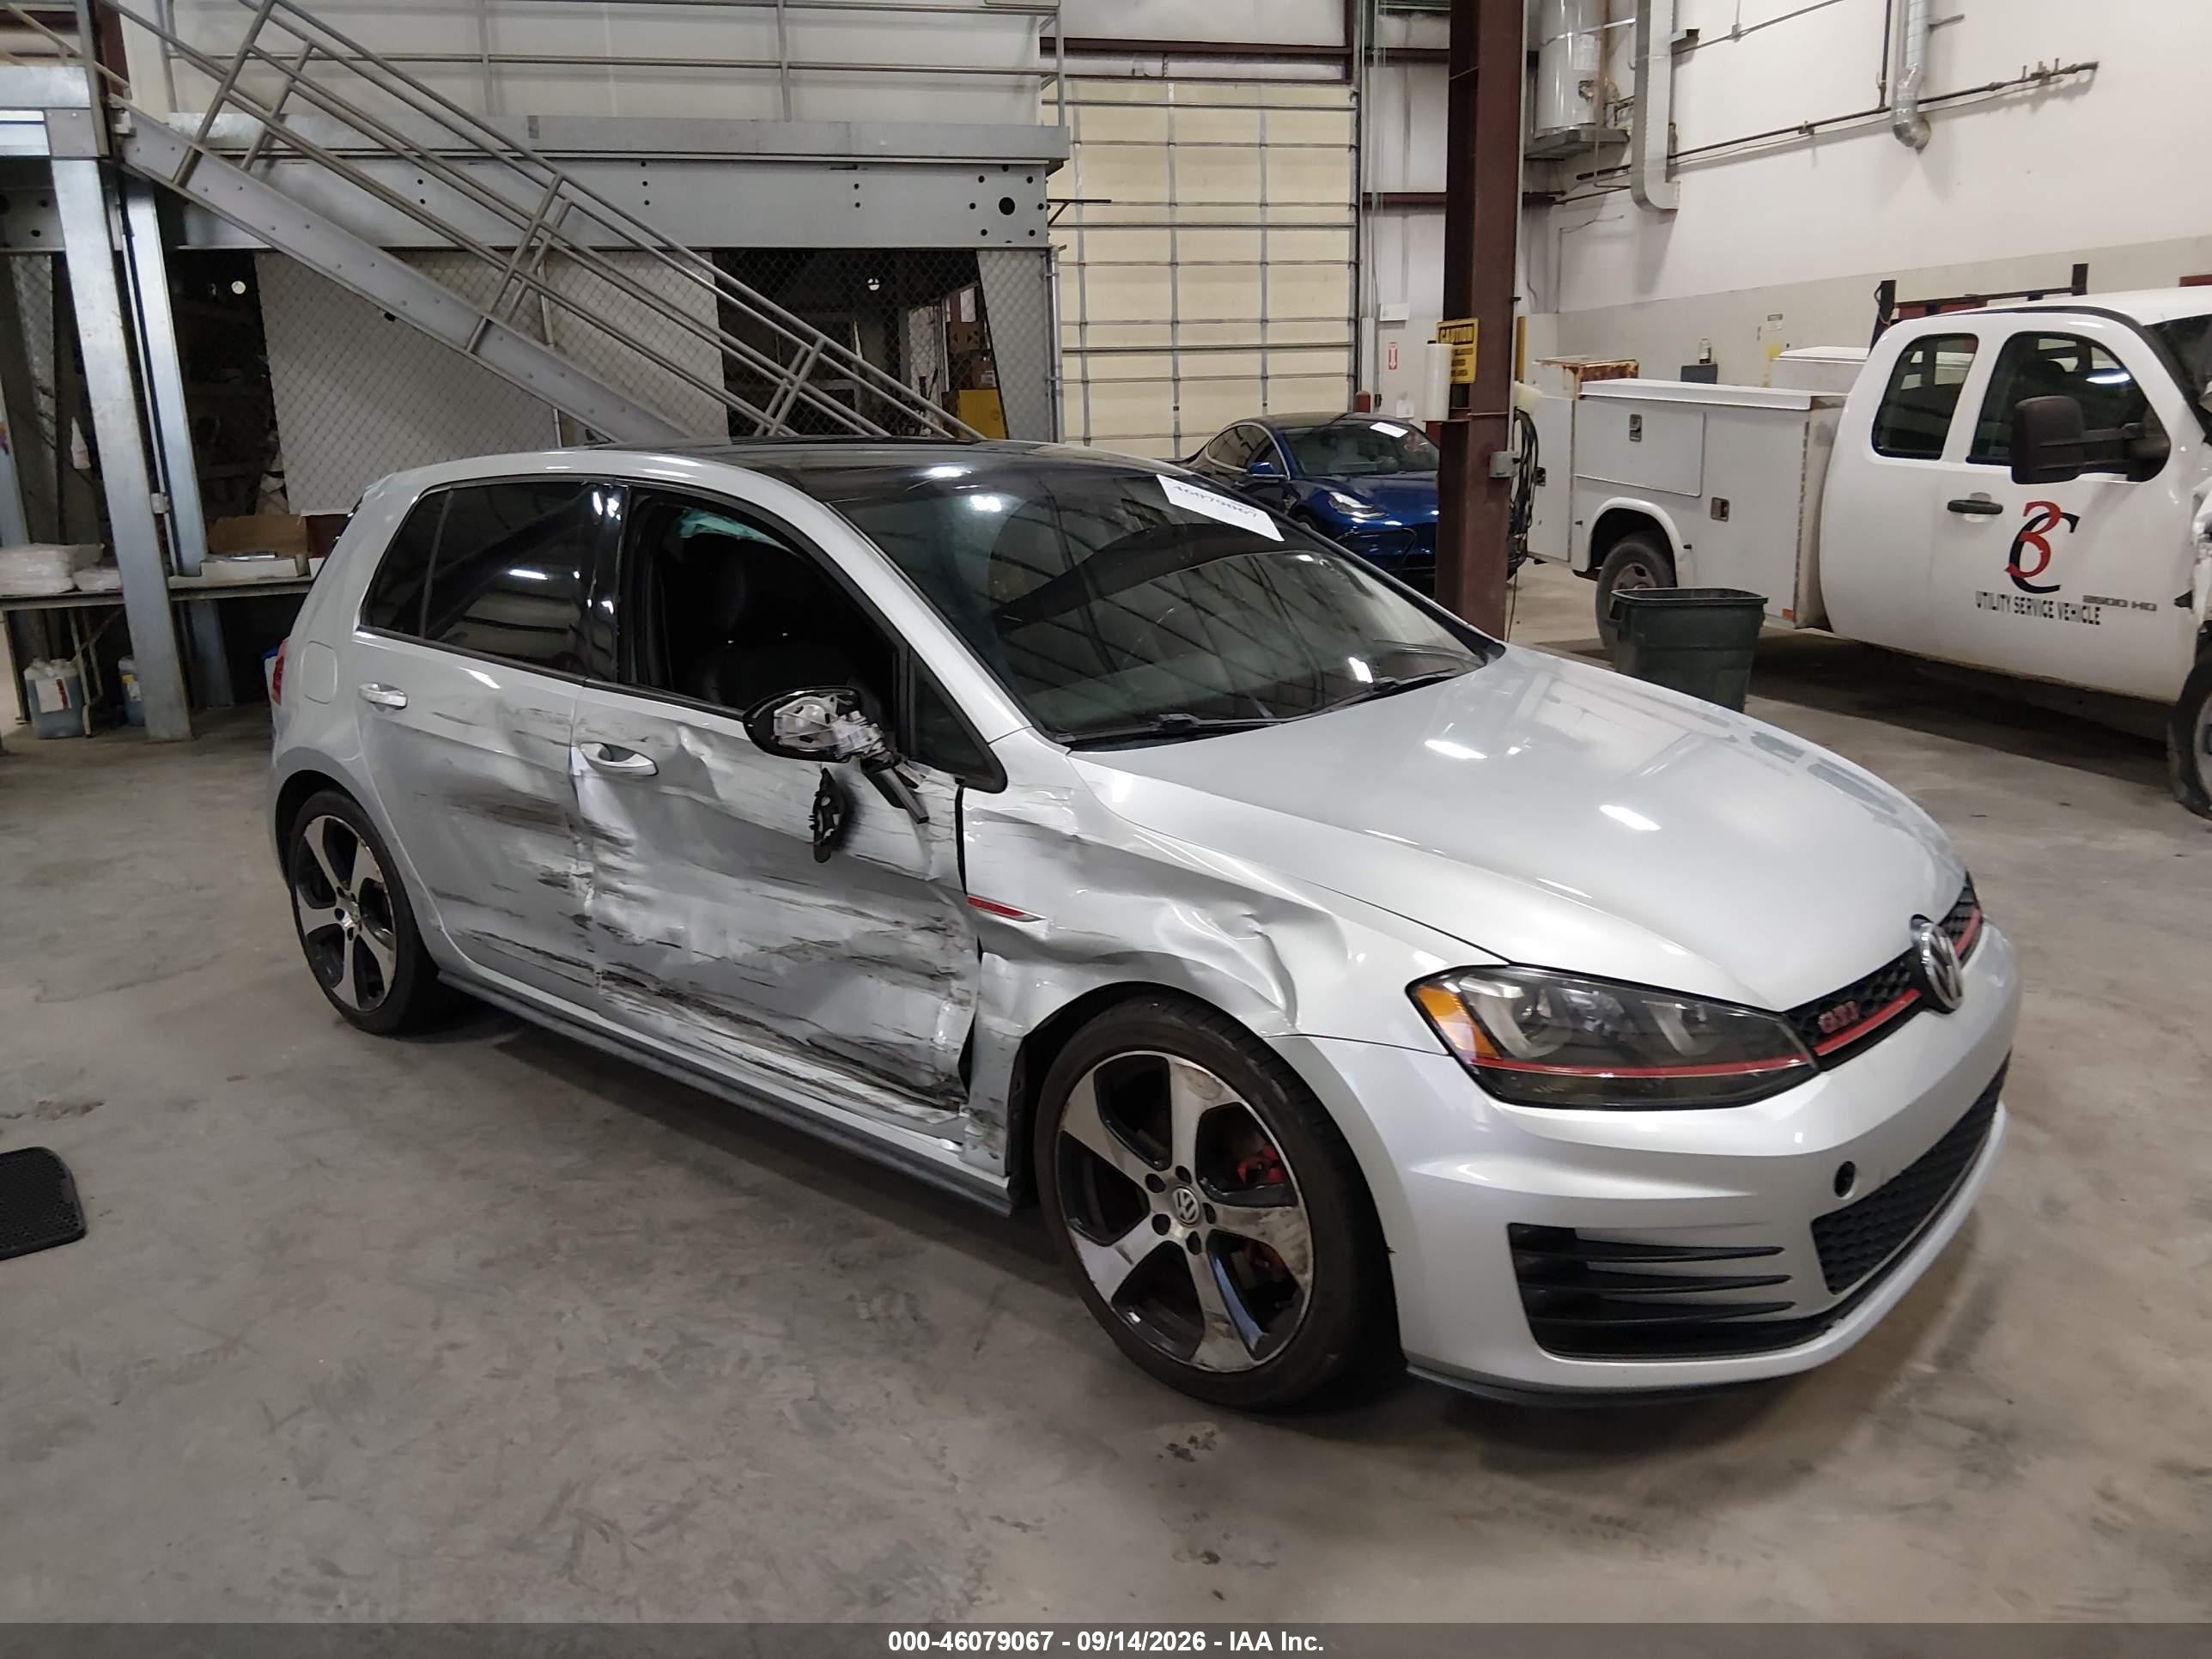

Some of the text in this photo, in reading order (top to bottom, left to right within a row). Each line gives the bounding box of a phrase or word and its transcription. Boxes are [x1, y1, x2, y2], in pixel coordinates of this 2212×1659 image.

[1976, 591, 2100, 625] UTILITY SERVICE VEHICLE
[1818, 1000, 1860, 1034] GTI
